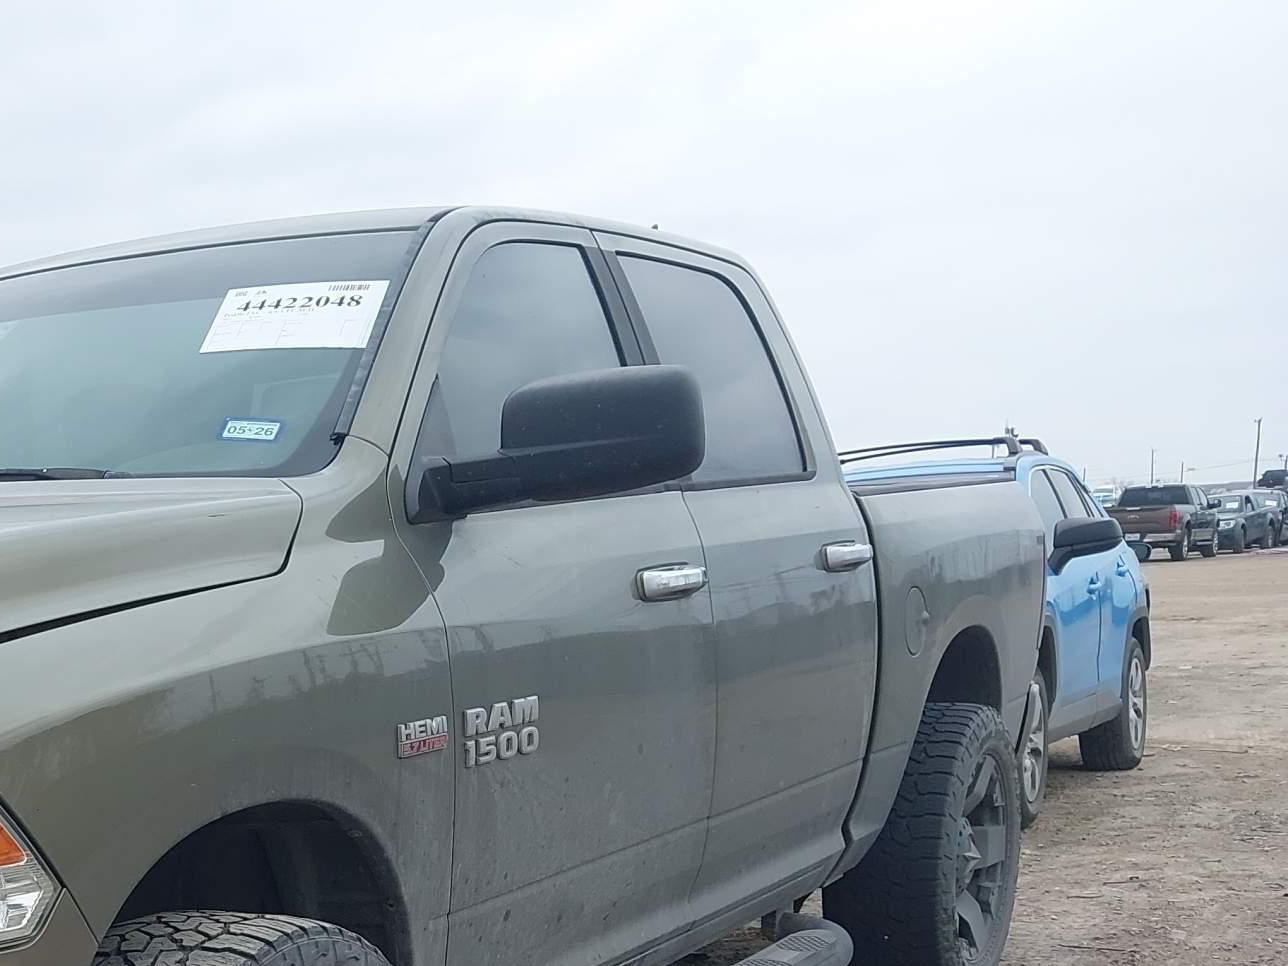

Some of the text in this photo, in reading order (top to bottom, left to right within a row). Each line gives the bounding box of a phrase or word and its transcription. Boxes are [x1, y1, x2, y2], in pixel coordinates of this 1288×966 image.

[237, 295, 364, 312] 44422048
[397, 715, 448, 742] HEMI
[463, 695, 539, 737] RAM
[464, 726, 540, 768] 1500
